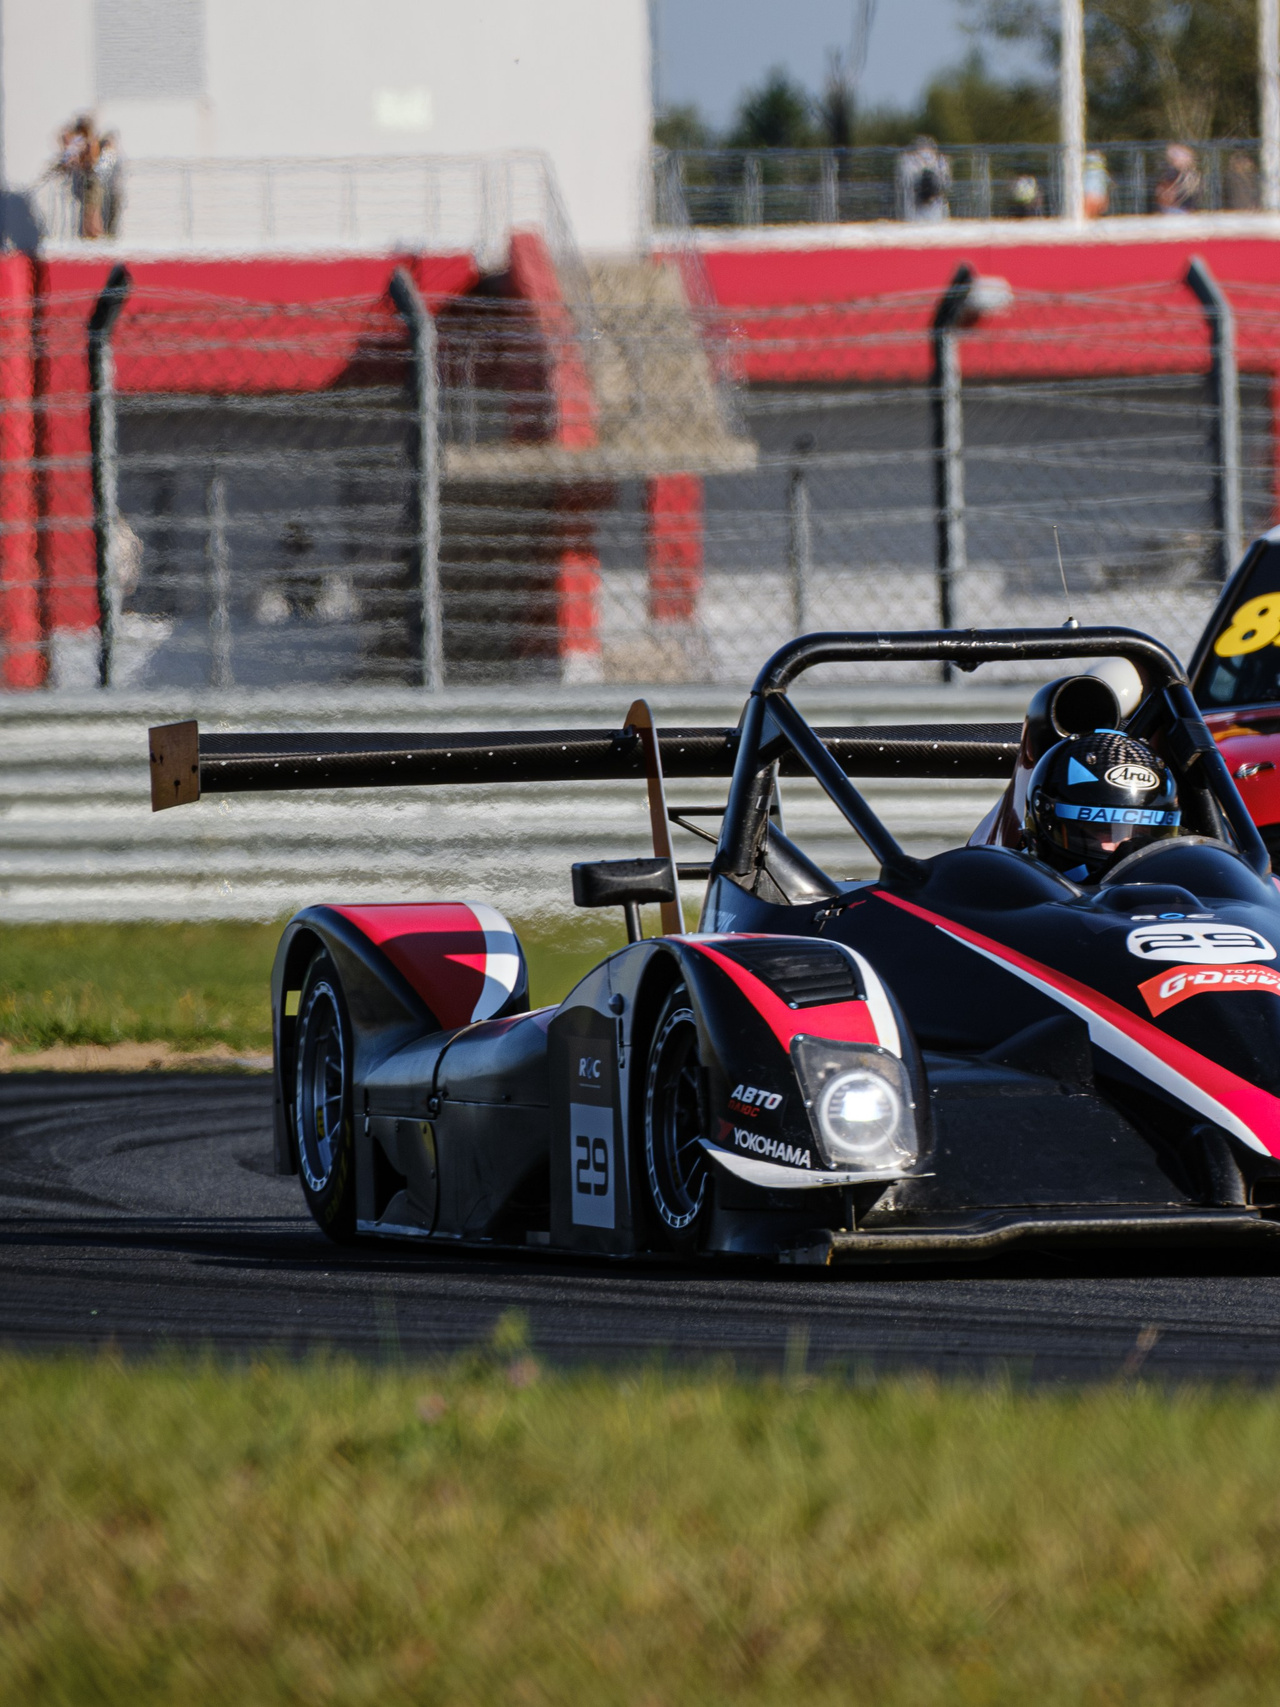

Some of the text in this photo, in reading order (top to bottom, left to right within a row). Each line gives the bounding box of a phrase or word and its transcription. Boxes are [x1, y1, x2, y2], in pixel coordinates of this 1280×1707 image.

[1110, 768, 1152, 783] Arai
[1077, 807, 1175, 825] BALCHUG
[1135, 933, 1266, 953] 29
[731, 1084, 783, 1110] АВТО
[733, 1127, 812, 1169] YOKOHAMA
[576, 1135, 608, 1197] 29
